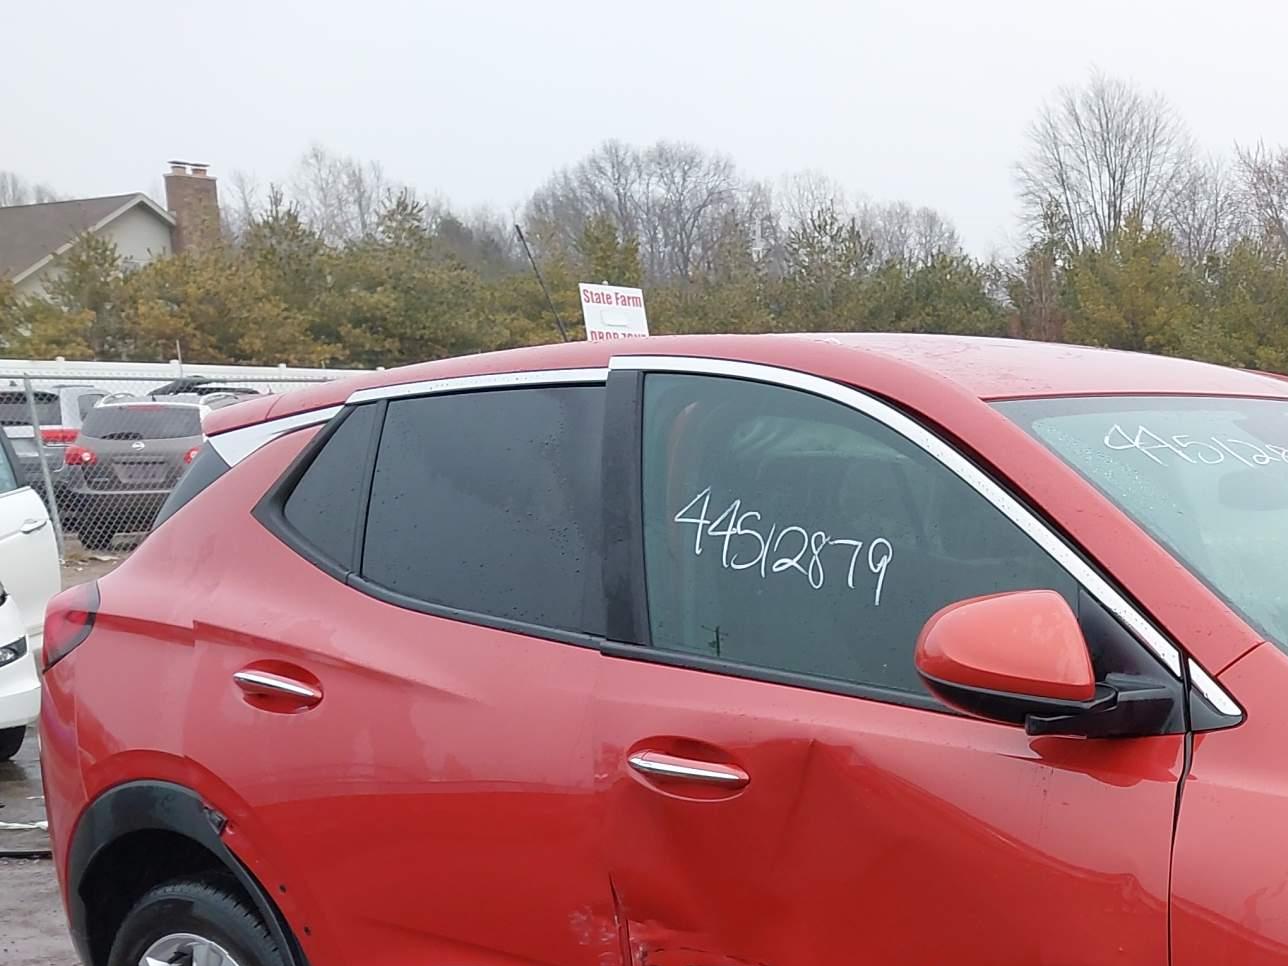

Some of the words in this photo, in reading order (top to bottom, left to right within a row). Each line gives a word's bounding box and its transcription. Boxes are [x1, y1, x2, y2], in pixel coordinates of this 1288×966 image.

[583, 289, 612, 305] State
[614, 291, 642, 307] Farm
[673, 485, 893, 606] 44512879
